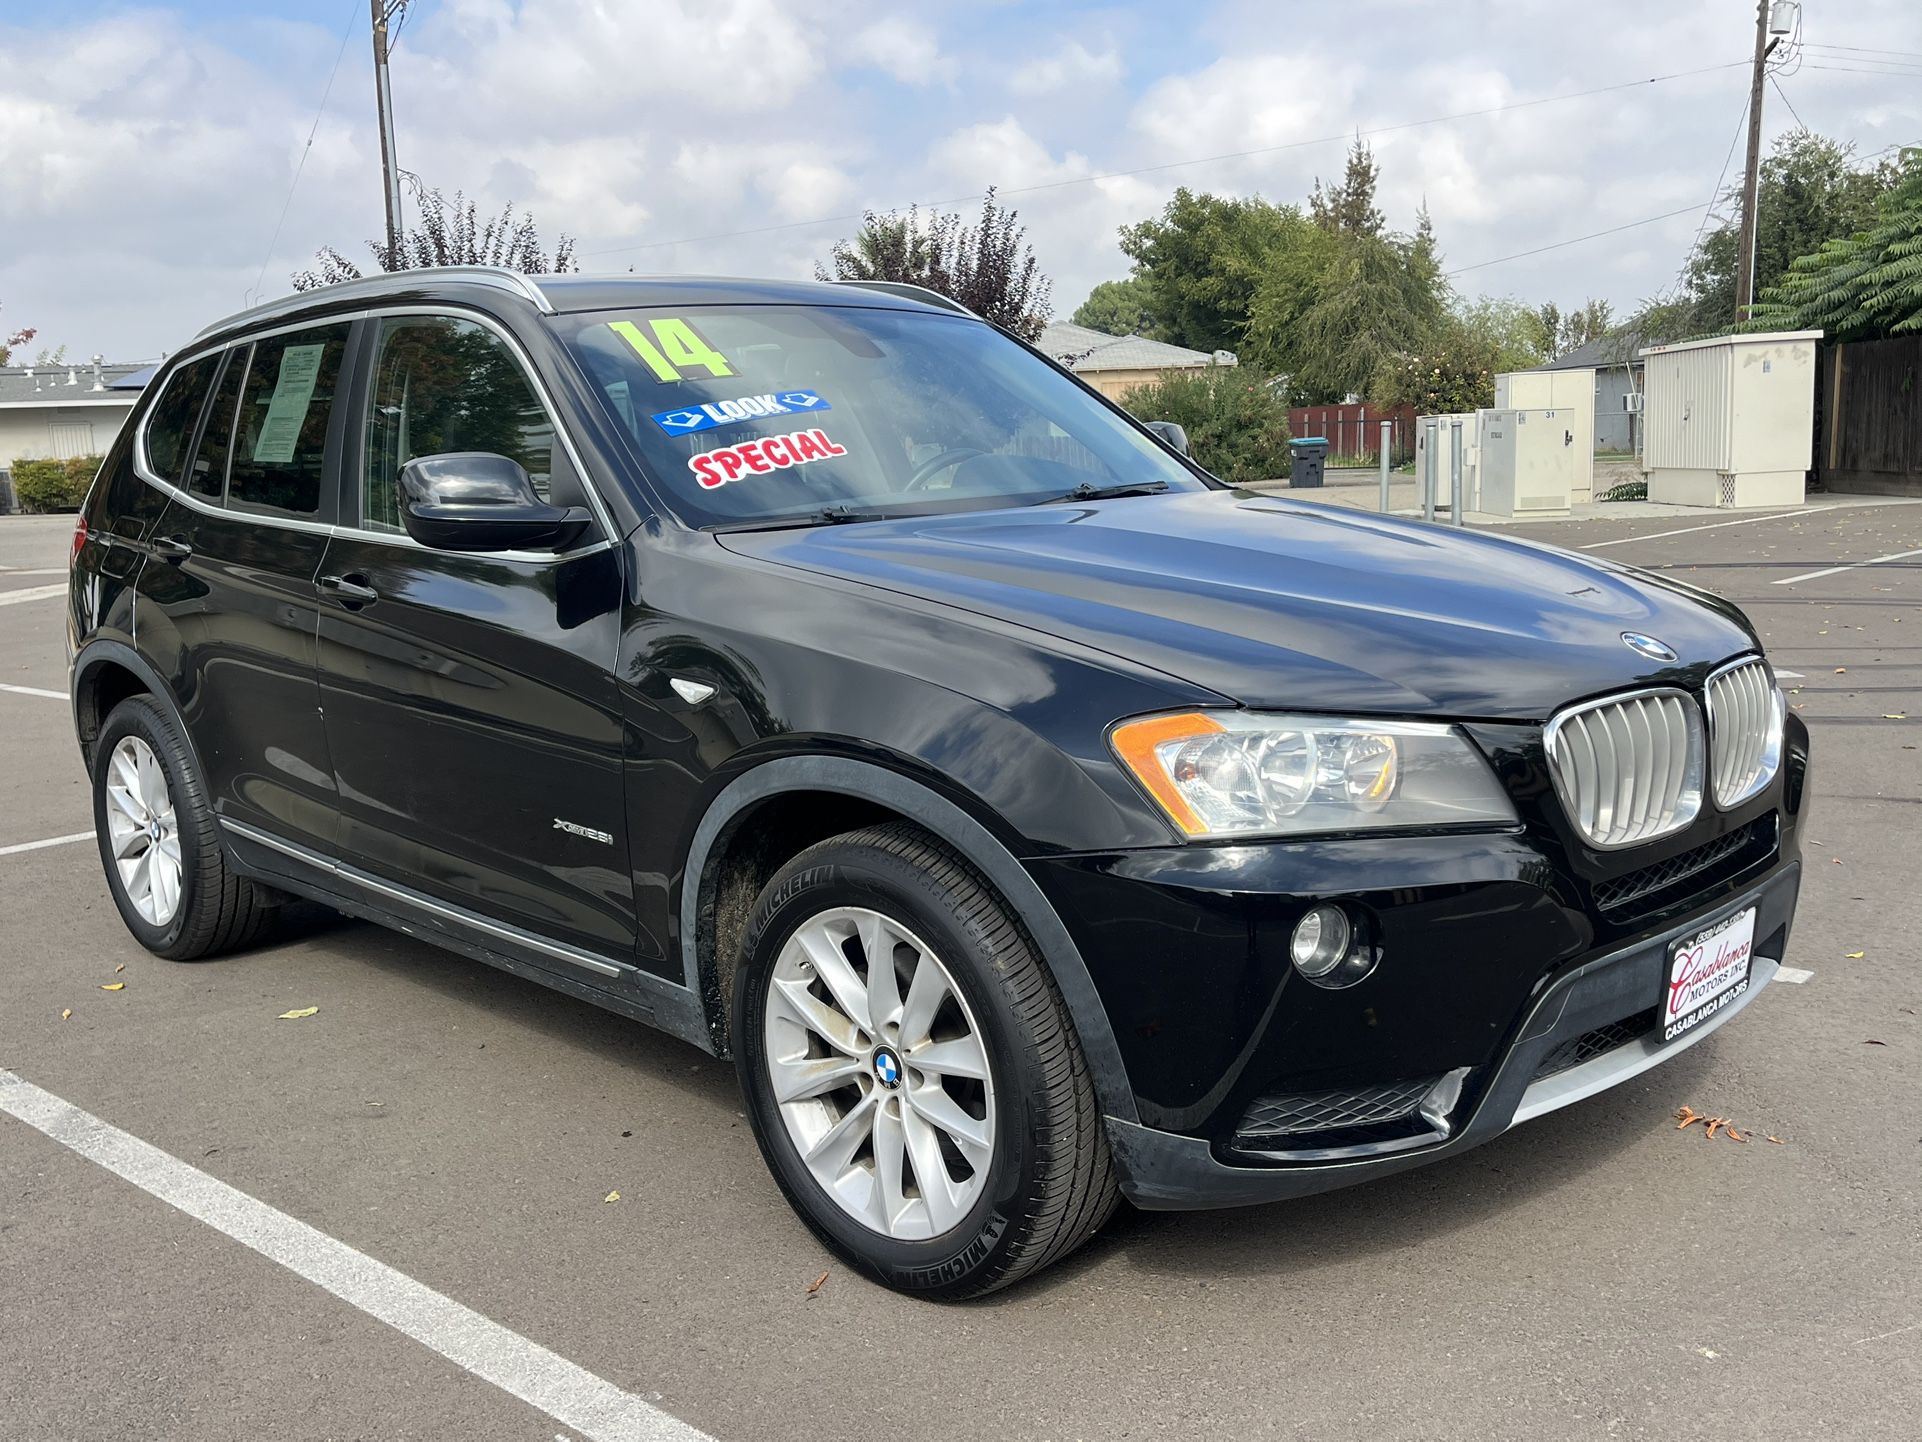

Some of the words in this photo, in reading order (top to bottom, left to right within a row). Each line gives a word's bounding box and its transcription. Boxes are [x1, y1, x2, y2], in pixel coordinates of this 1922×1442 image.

[607, 318, 735, 382] 14
[699, 394, 792, 425] LOOK
[1545, 411, 1555, 419] 31
[691, 430, 846, 488] SPECIAL
[755, 865, 834, 932] MICHELIN
[1669, 940, 1751, 1019] Casablanca
[1689, 970, 1729, 1002] MOTORS
[1730, 959, 1747, 979] INC.
[1665, 1000, 1718, 1041] CASABLANCA
[1718, 979, 1749, 1010] MOTORS
[896, 1236, 988, 1289] MICHELIN
